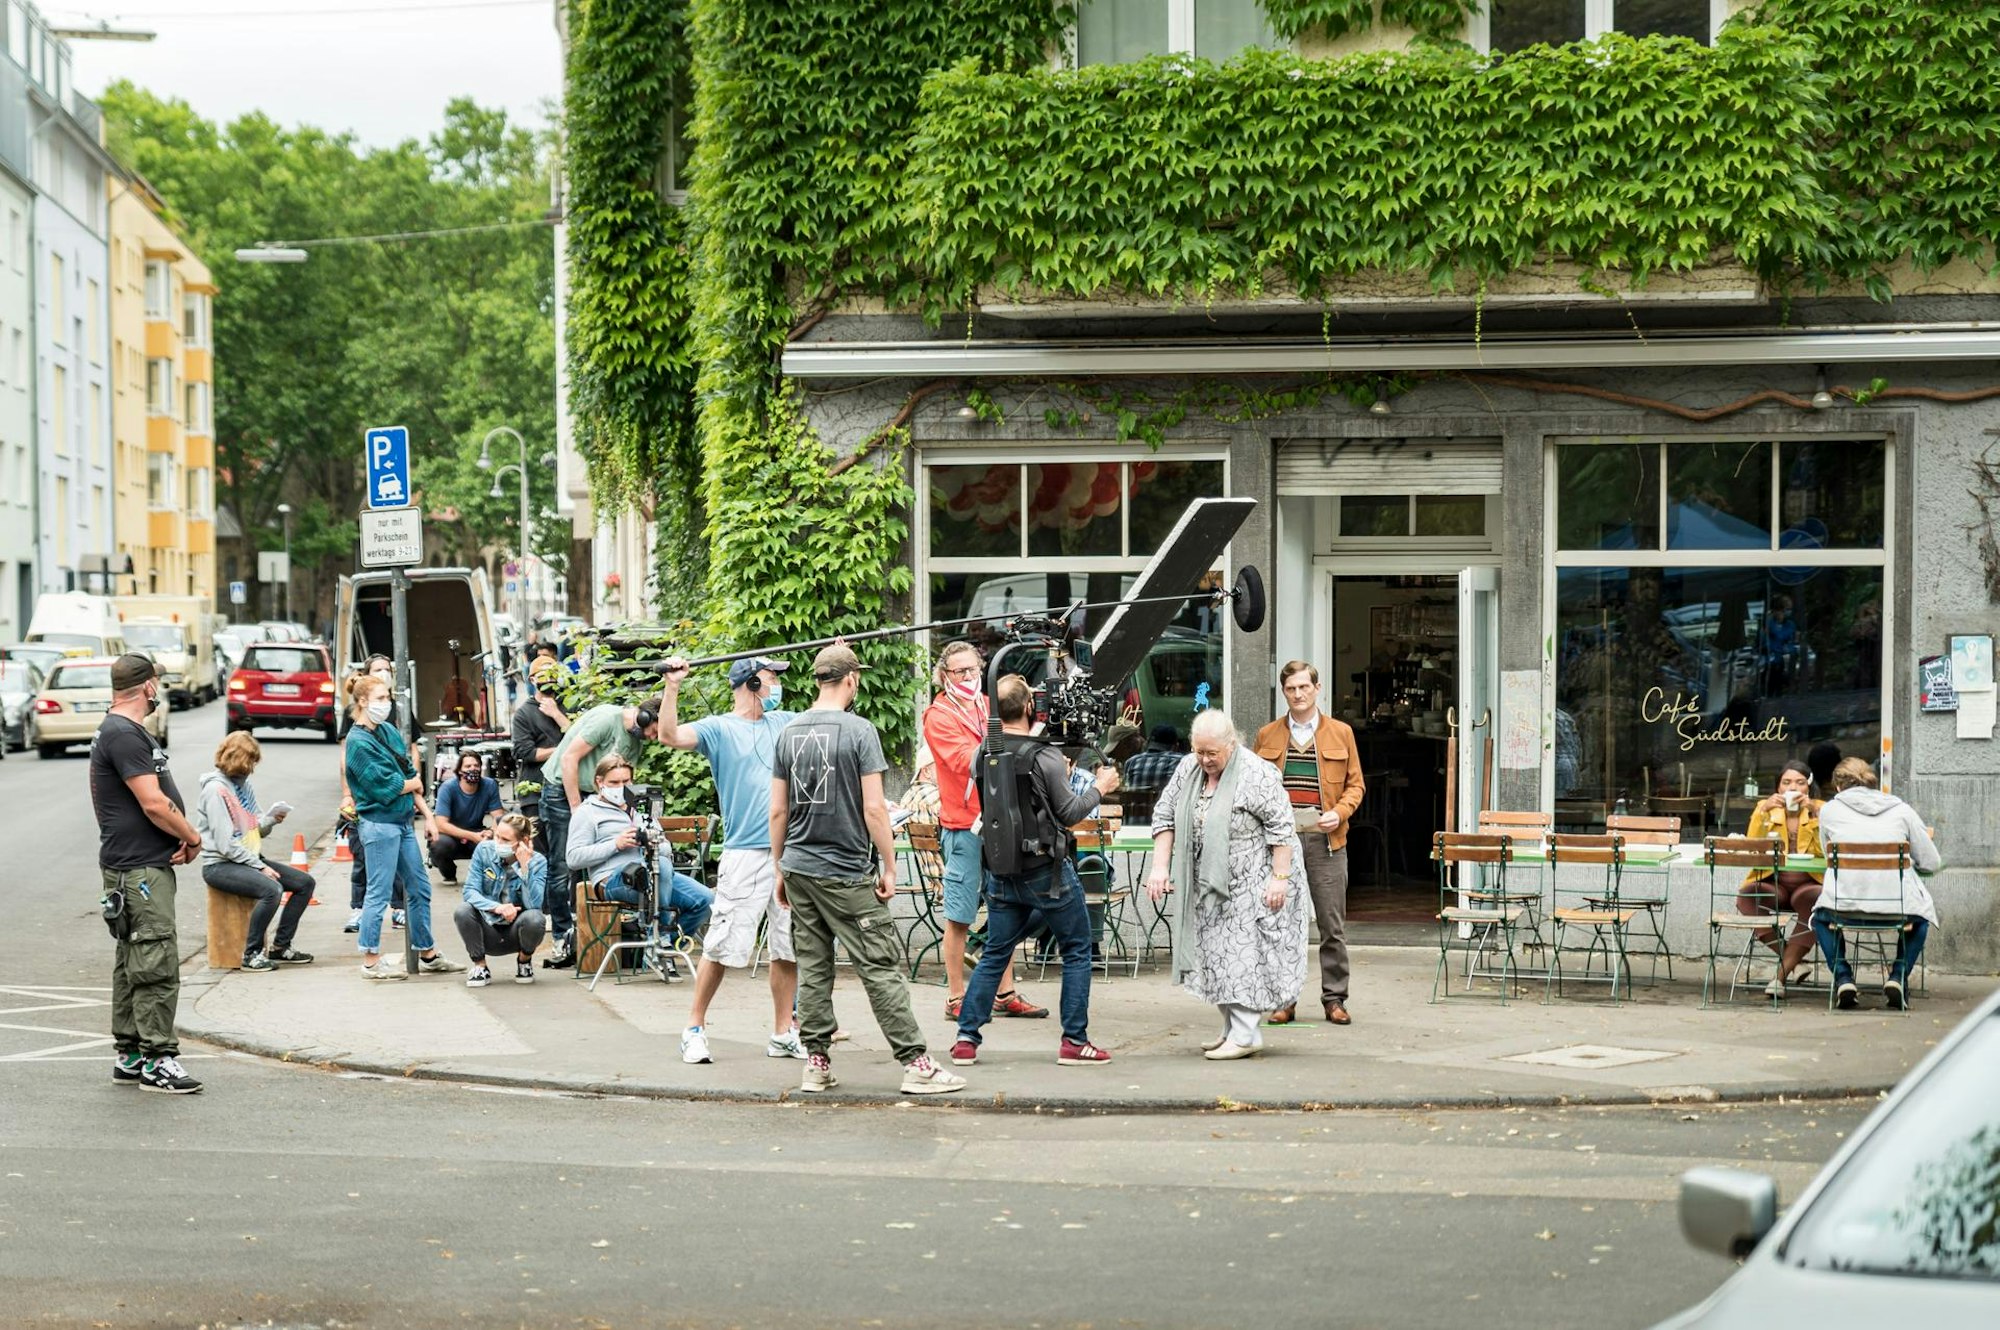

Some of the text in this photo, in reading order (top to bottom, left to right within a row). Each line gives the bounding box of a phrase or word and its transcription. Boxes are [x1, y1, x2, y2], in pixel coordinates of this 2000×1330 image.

[373, 436, 392, 470] P
[377, 517, 402, 527] nur mit
[373, 532, 408, 543] Parkschein
[366, 548, 396, 559] werktags
[1641, 686, 1699, 724] Café
[1676, 713, 1788, 751] Südstadt
